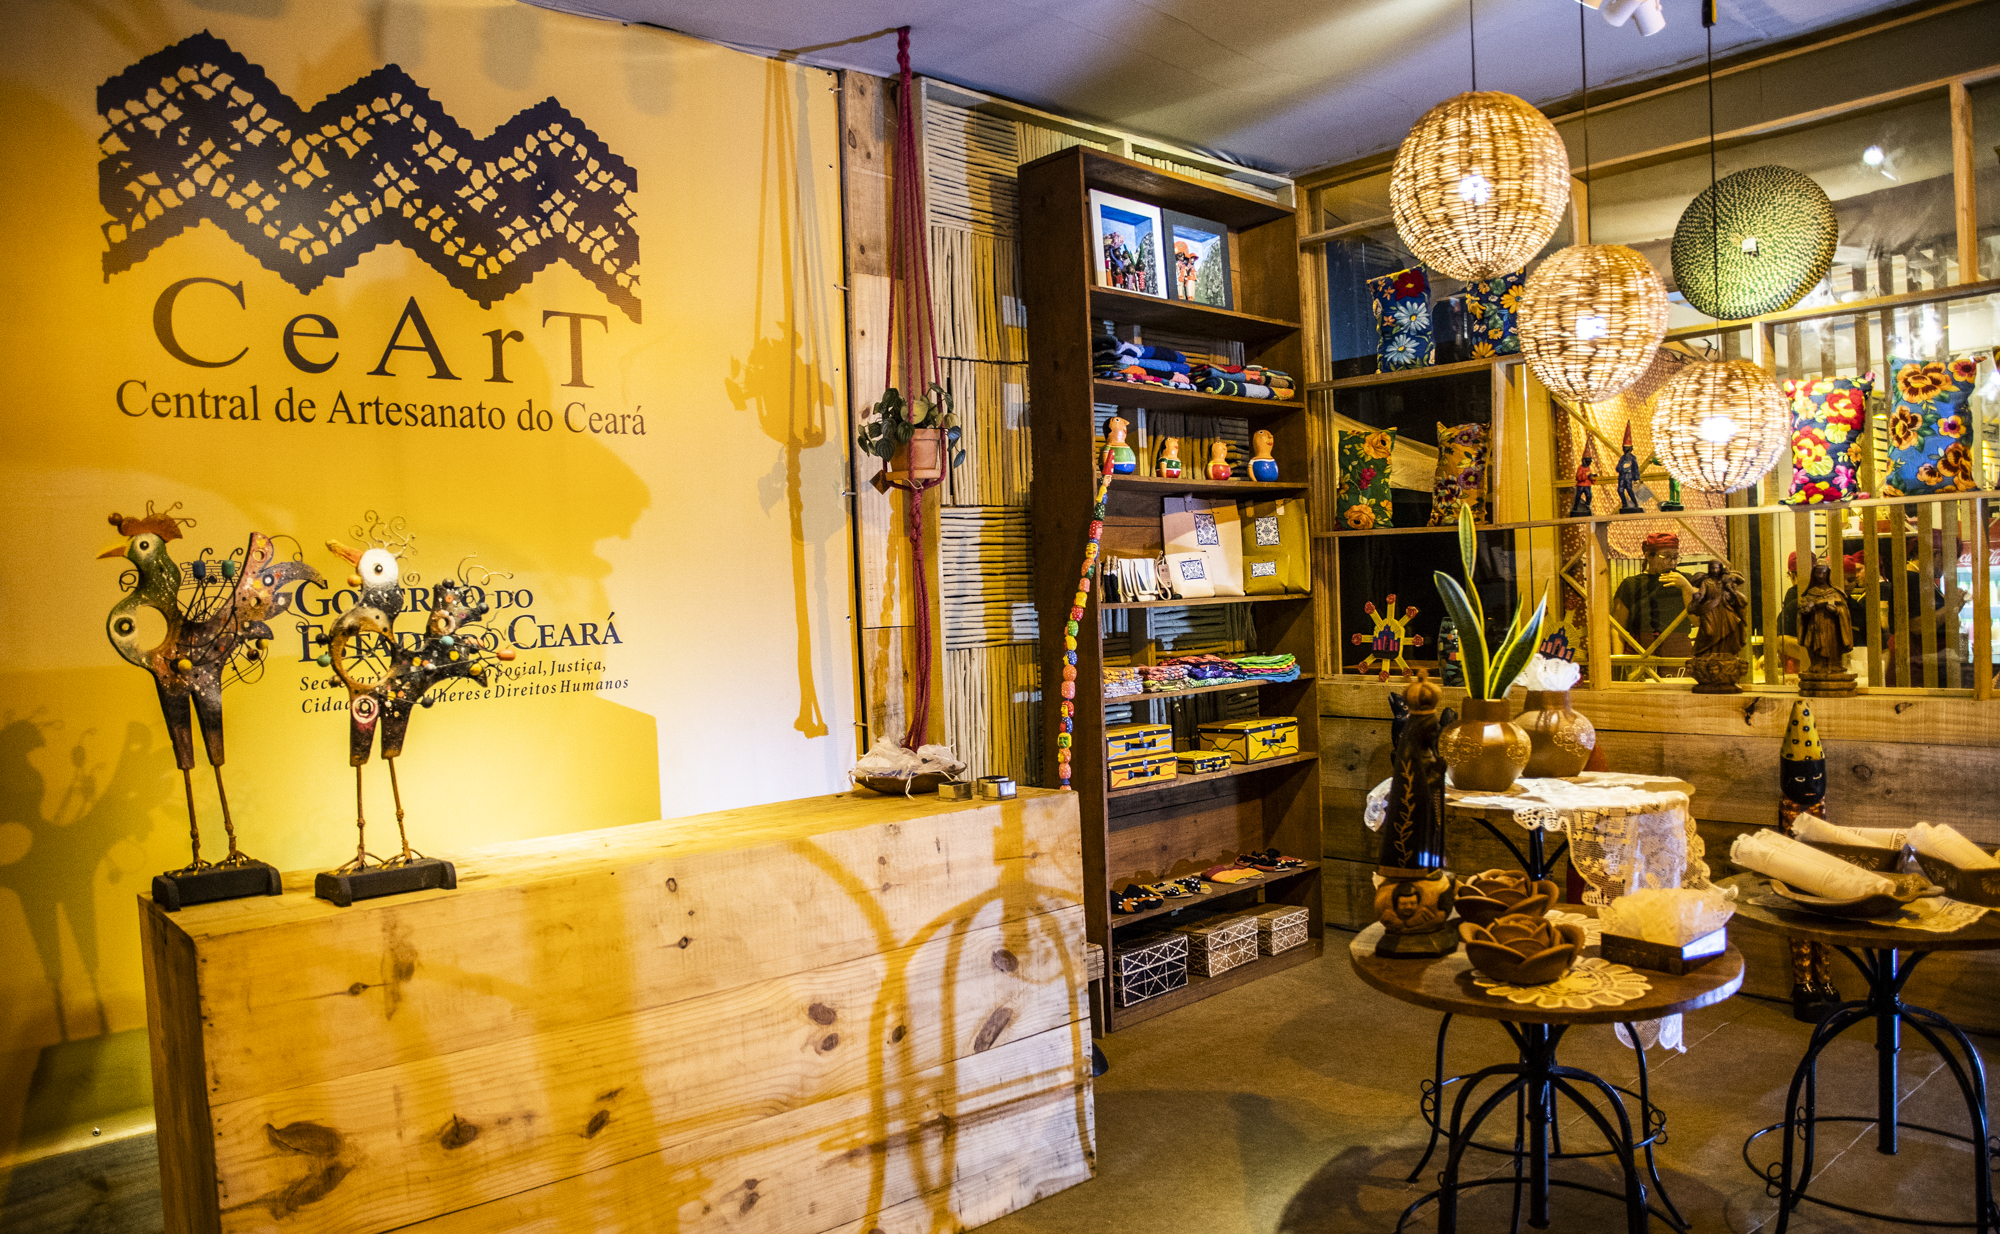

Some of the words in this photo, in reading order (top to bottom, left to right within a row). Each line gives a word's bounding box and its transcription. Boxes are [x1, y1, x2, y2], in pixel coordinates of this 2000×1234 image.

[152, 277, 609, 389] CeArT
[116, 379, 260, 423] Central
[274, 386, 316, 424] de
[327, 390, 506, 430] Artesanato
[516, 399, 553, 432] do
[563, 402, 647, 436] Ceará
[508, 612, 623, 650] CEARÁ
[549, 658, 606, 677] Justiça,
[483, 688, 491, 699] e
[494, 681, 557, 698] Direitos
[560, 678, 629, 694] Humanos
